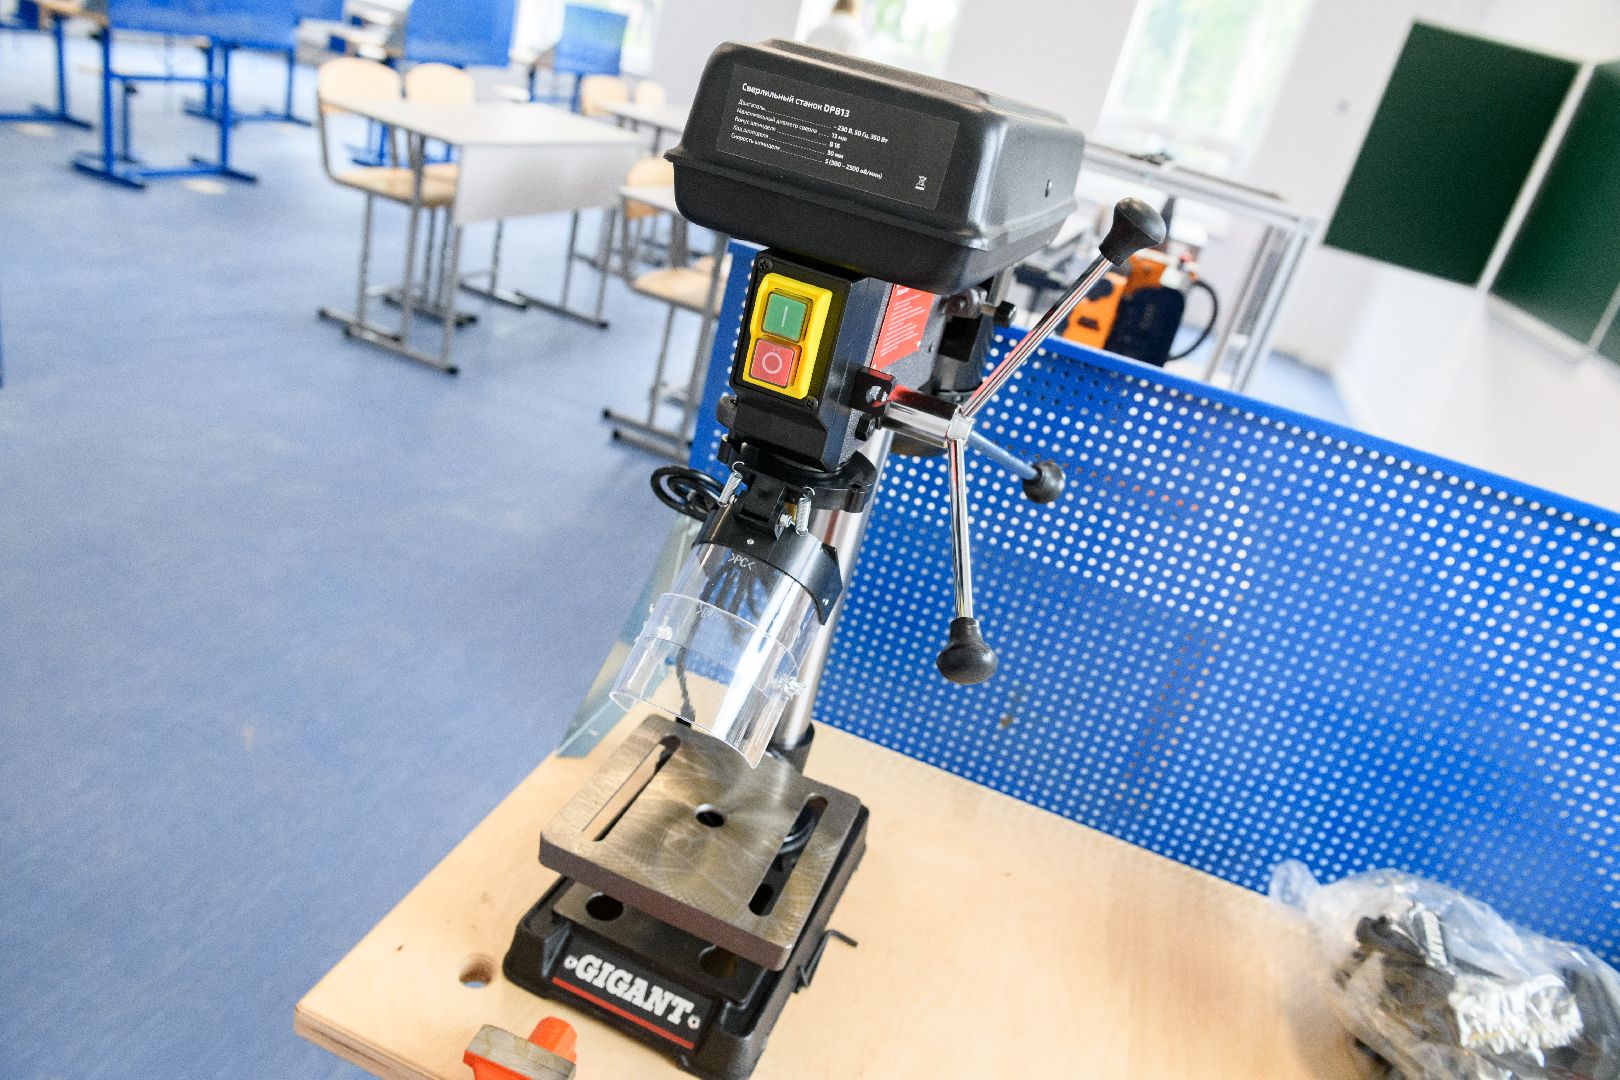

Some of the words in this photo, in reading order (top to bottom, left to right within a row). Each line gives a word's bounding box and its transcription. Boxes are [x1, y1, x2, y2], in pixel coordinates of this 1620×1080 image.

[742, 83, 794, 103] Сверлильный
[796, 98, 822, 110] станок
[824, 104, 850, 118] DP813
[575, 954, 695, 1025] GIGANT
